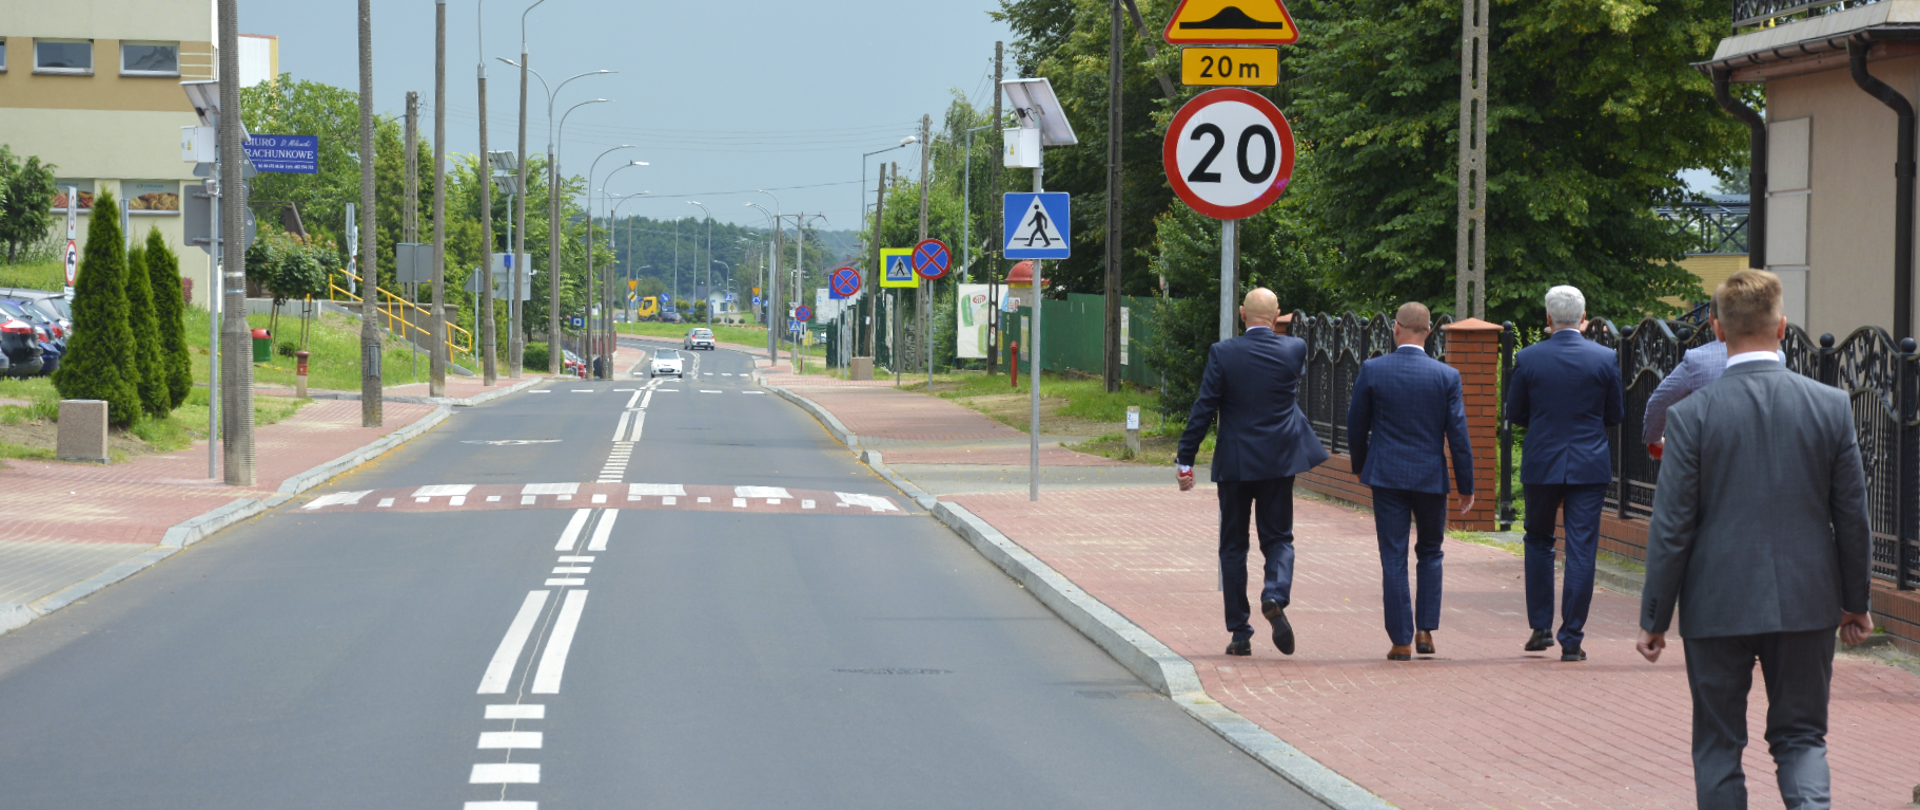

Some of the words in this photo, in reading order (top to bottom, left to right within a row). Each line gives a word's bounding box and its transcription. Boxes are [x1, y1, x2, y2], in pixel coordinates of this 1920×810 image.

[1200, 55, 1232, 78] 20
[1239, 63, 1260, 78] m
[245, 149, 313, 159] RACHUNKOWE
[1187, 123, 1276, 184] 20
